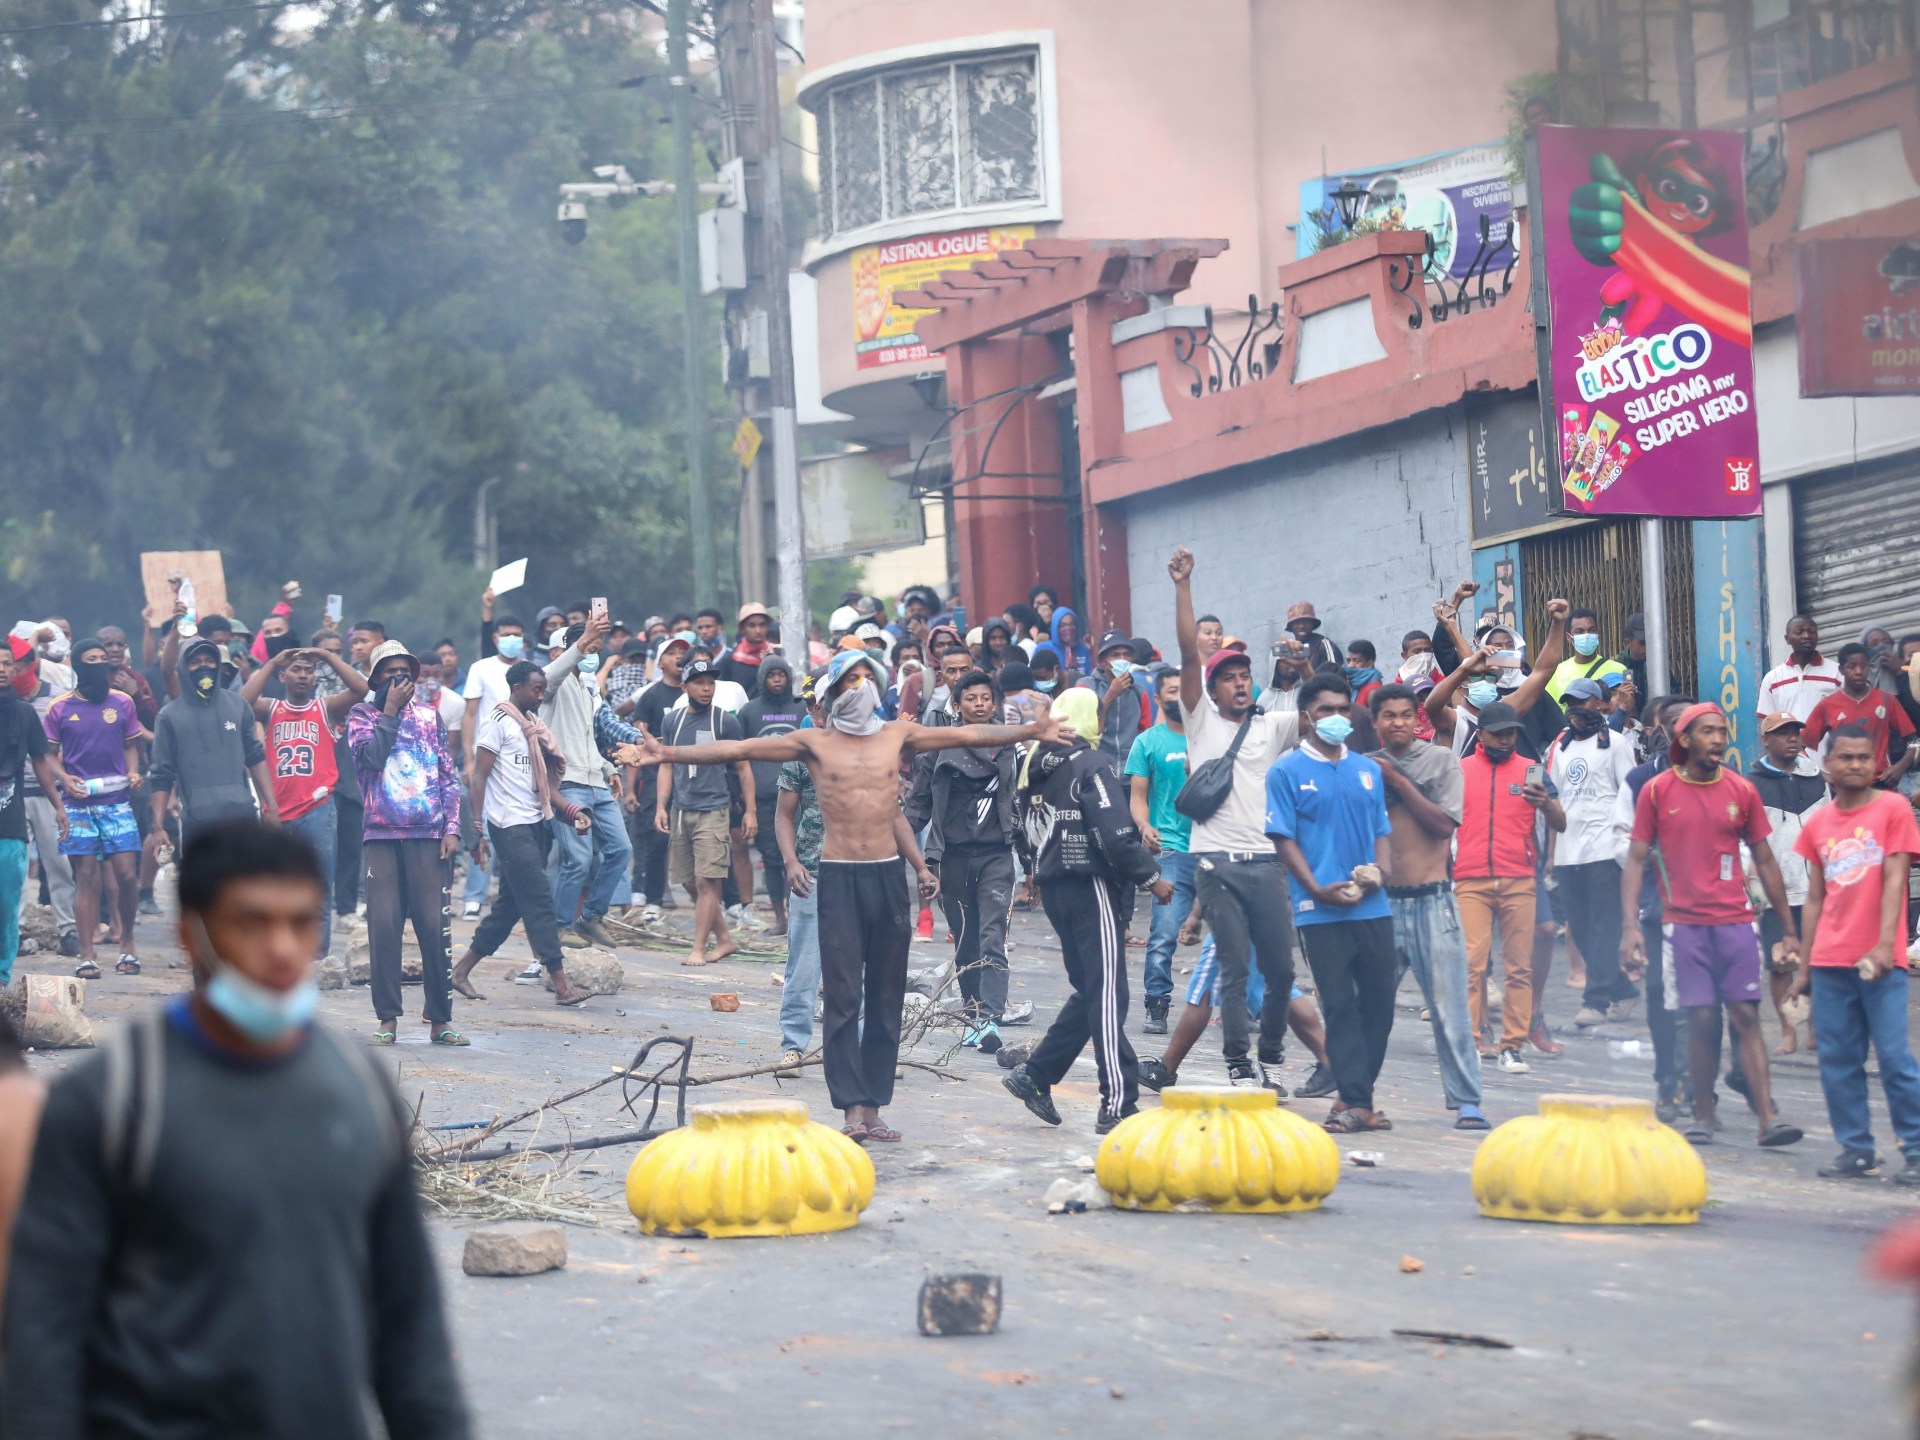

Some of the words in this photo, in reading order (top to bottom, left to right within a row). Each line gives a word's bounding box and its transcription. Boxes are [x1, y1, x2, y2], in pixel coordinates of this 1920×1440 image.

[880, 232, 989, 265] ASTROLOGUE
[1582, 329, 1621, 361] BOOM
[1624, 374, 1712, 424] SILIGOMA
[1636, 410, 1700, 451] SUPER
[1698, 389, 1749, 427] HERO
[1730, 473, 1750, 491] JB
[273, 720, 319, 748] BULLS
[277, 745, 315, 778] 23
